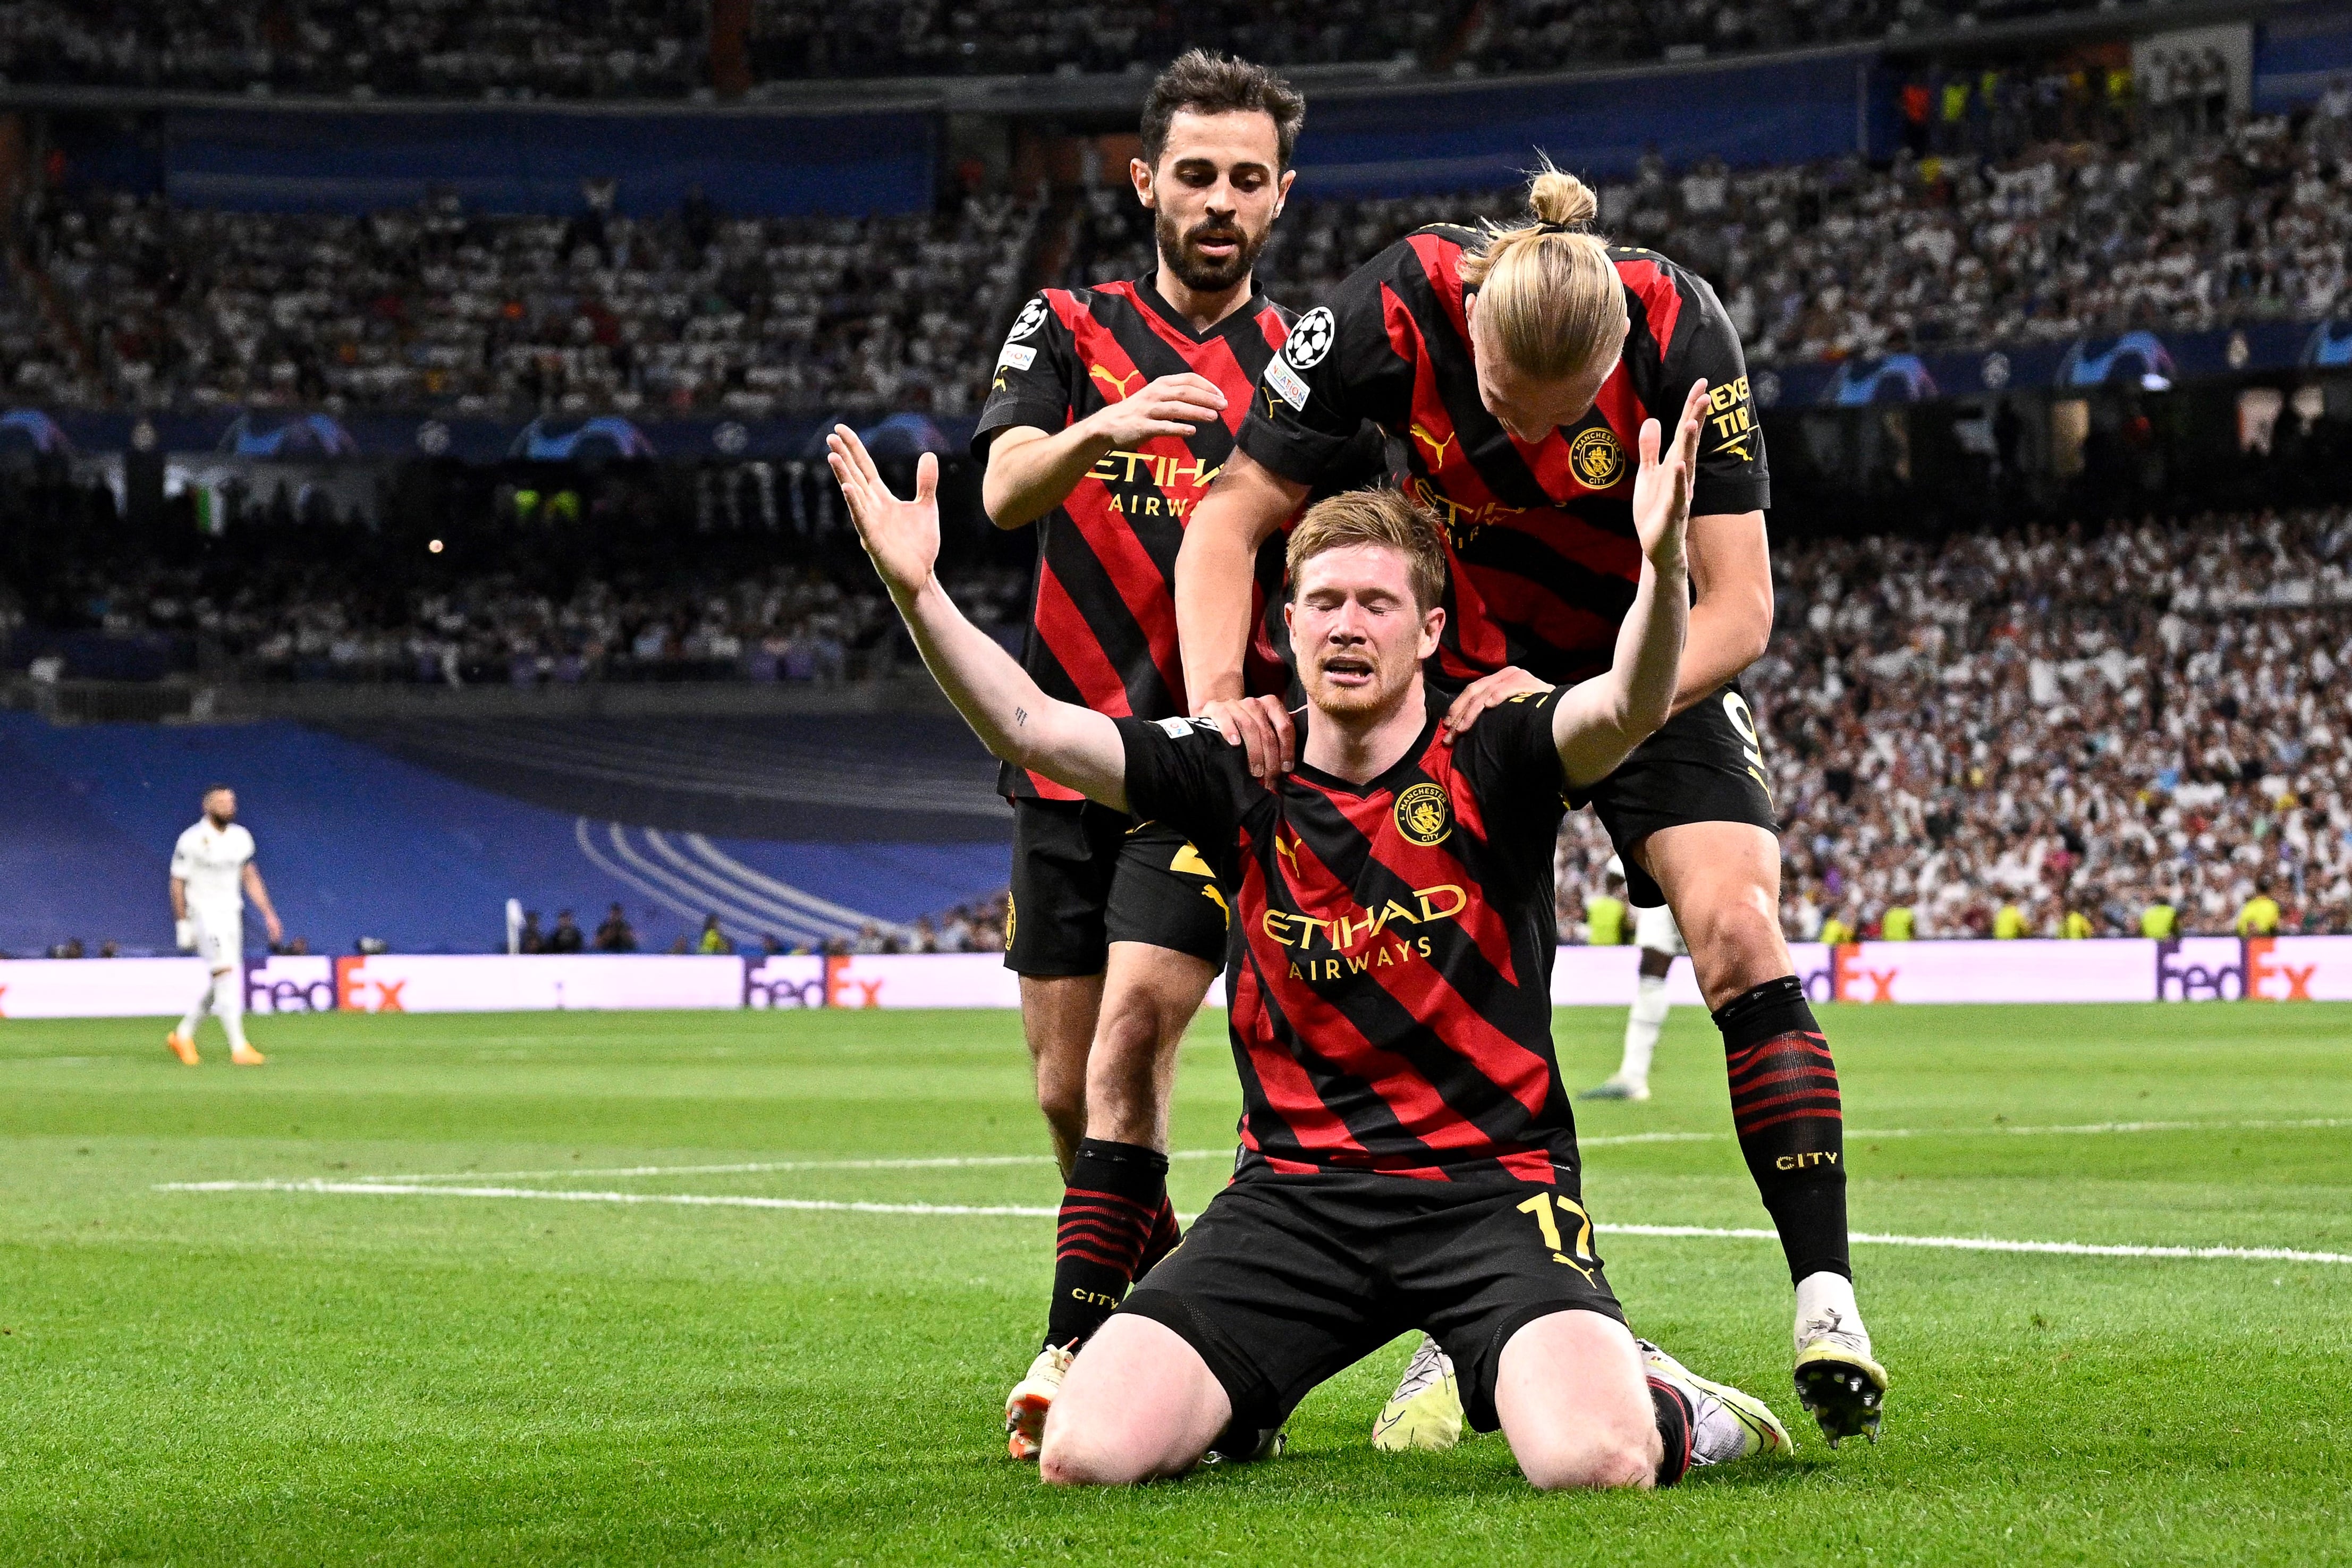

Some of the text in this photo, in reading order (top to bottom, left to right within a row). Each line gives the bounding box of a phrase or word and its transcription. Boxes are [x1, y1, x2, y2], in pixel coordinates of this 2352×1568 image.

[1705, 375, 1749, 416] EXE
[1575, 431, 1621, 452] MANCHESTER
[1713, 406, 1749, 438] TIR
[1085, 450, 1224, 487] ETIH
[1108, 493, 1202, 518] AIRW
[1400, 787, 1446, 811] MANCHESTER
[1422, 833, 1439, 842] CITY
[1263, 884, 1467, 951] ETIHAD
[1289, 936, 1432, 981] AIRWAYS
[1801, 943, 1897, 1002] dEx
[2156, 939, 2315, 1001] FedEx
[244, 955, 407, 1012] FedEx
[742, 956, 883, 1010] FedEx
[1776, 1152, 1838, 1171] CITY
[1516, 1192, 1593, 1262] 17
[1072, 1288, 1119, 1310] CITY
